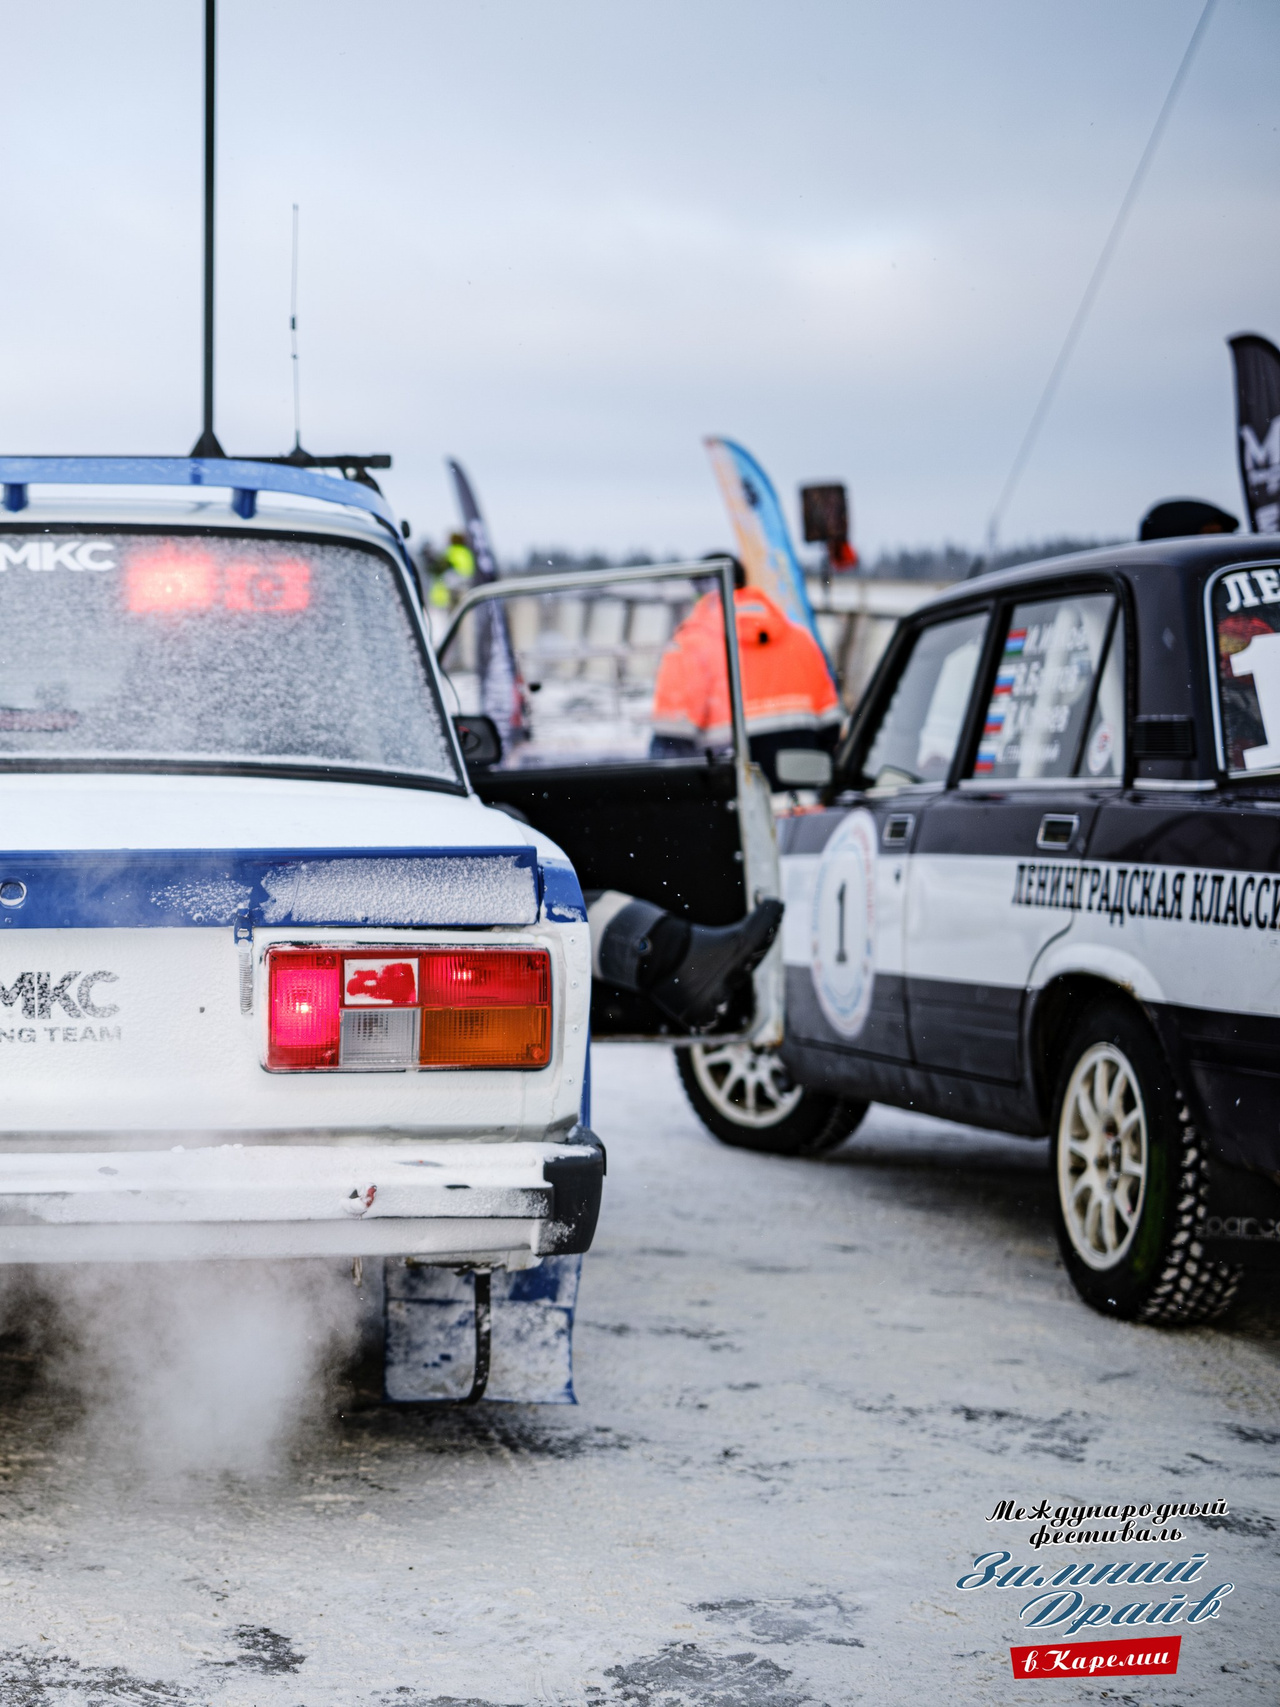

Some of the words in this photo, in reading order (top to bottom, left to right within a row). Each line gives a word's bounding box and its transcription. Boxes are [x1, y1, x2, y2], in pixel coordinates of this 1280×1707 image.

[1221, 568, 1280, 613] ЛЕ
[1011, 863, 1186, 927] ЛЕНИНГРАДСКАЯ
[835, 877, 848, 964] 1
[43, 1025, 122, 1044] TEAM
[1196, 1216, 1280, 1239] parc
